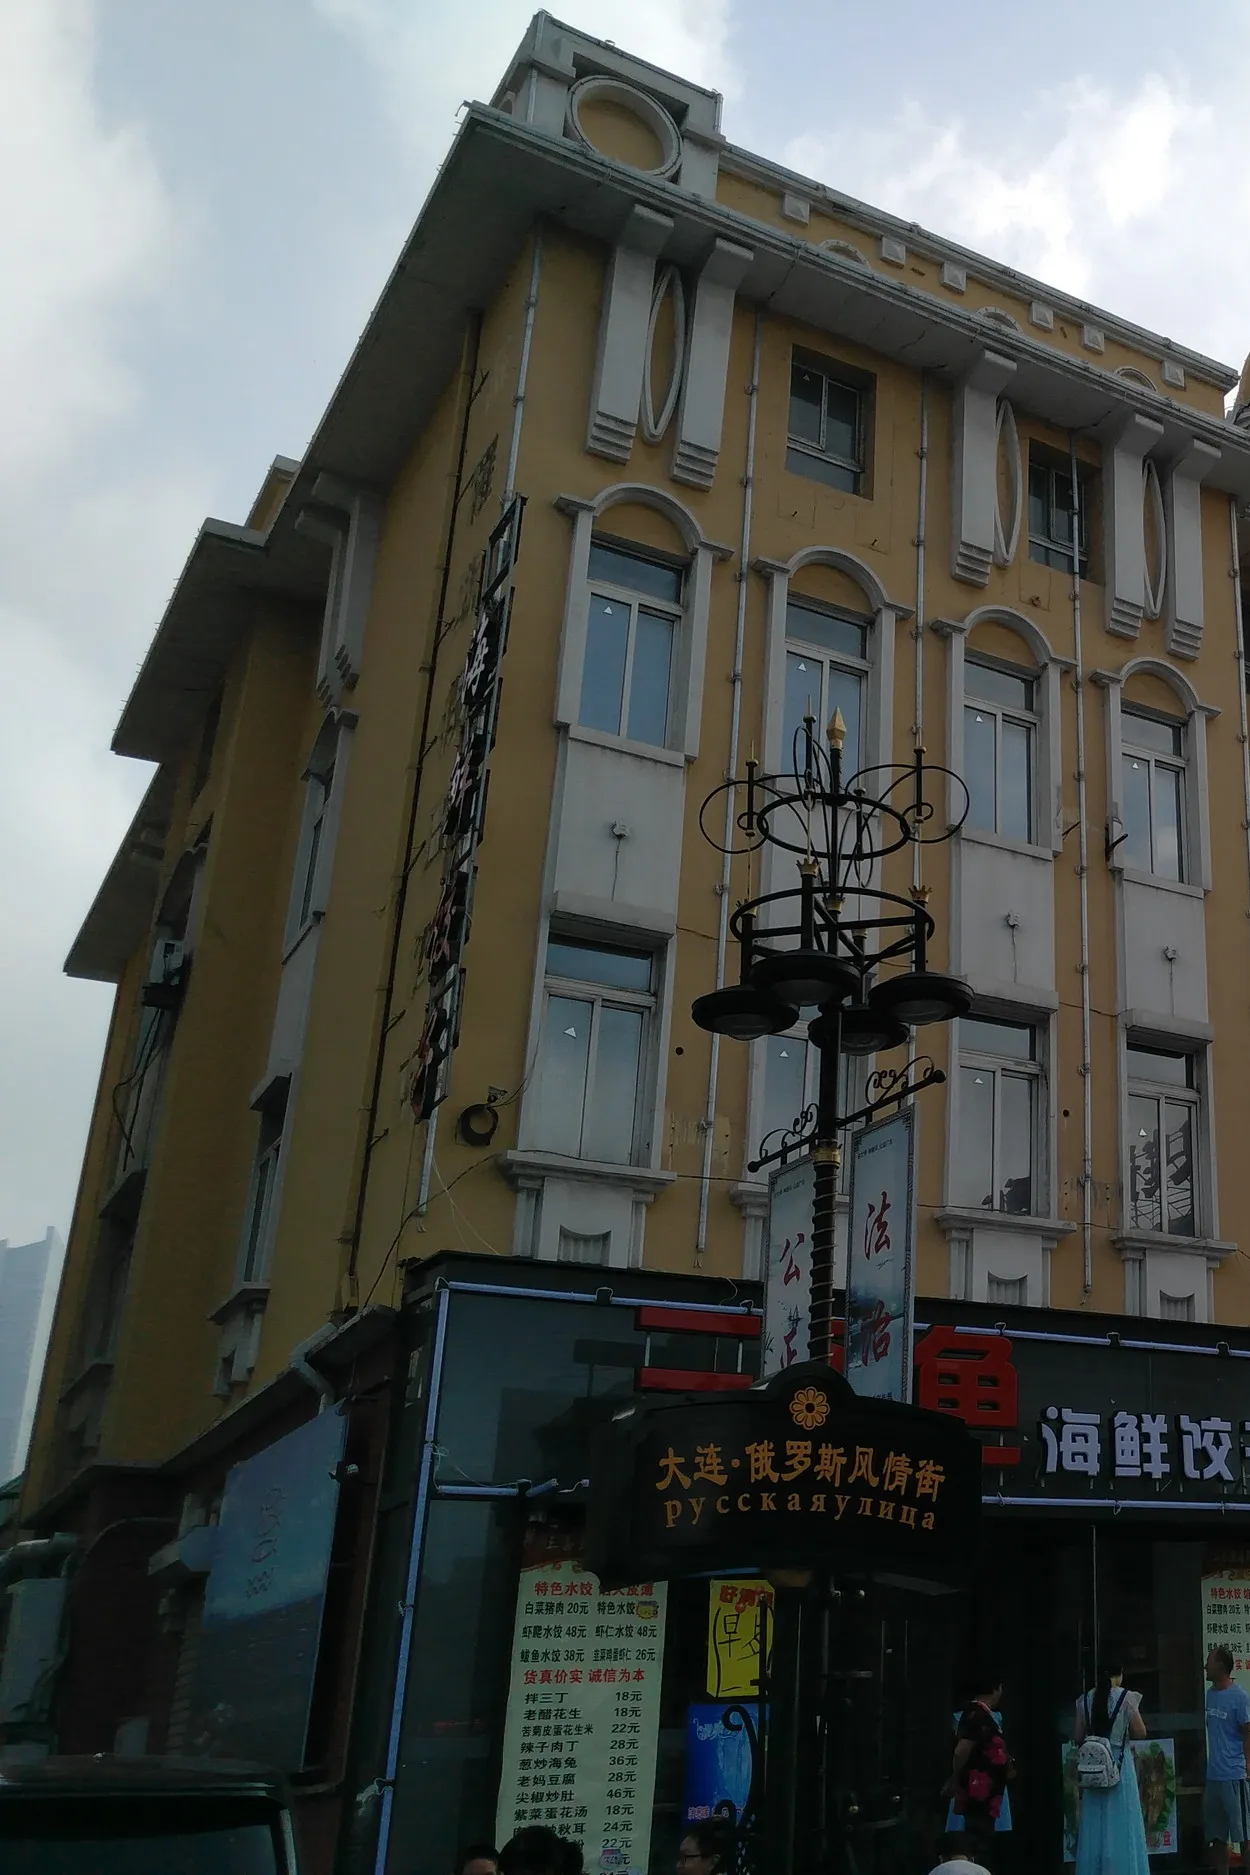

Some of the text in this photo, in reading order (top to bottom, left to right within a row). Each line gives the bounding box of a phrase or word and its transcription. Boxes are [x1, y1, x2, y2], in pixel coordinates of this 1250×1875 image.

[860, 1190, 893, 1367] 法治
[779, 1232, 805, 1369] 公正
[656, 1440, 946, 1503] 大连·俄罗斯风情街
[535, 1581, 593, 1597] 特色水饺
[1211, 1588, 1241, 1600] 特色水饺
[524, 1601, 564, 1615] 白菜猪肉
[567, 1602, 589, 1615] 20元
[597, 1601, 636, 1615] 特色水饺
[522, 1625, 658, 1639] 虾爬水饺 48元 虾仁水饺 48元
[520, 1648, 561, 1663] 鲅鱼水饺
[564, 1648, 585, 1662] 38元
[635, 1648, 656, 1662] 26元
[524, 1668, 645, 1685] 货真价实 诚信为本
[525, 1690, 643, 1704] 拌三丁 18元
[523, 1706, 641, 1720] 老醋花生 18元
[611, 1722, 640, 1734] 22元
[520, 1738, 639, 1753] 辣子肉丁 28元
[609, 1754, 638, 1766] 36元
[517, 1771, 636, 1787] 老妈豆腐 28元
[515, 1787, 635, 1804] 尖椒炒肚 46元
[513, 1804, 634, 1821] 紫菜蛋花汤 18元
[602, 1820, 632, 1832] 24元
[601, 1836, 632, 1849] 22元
